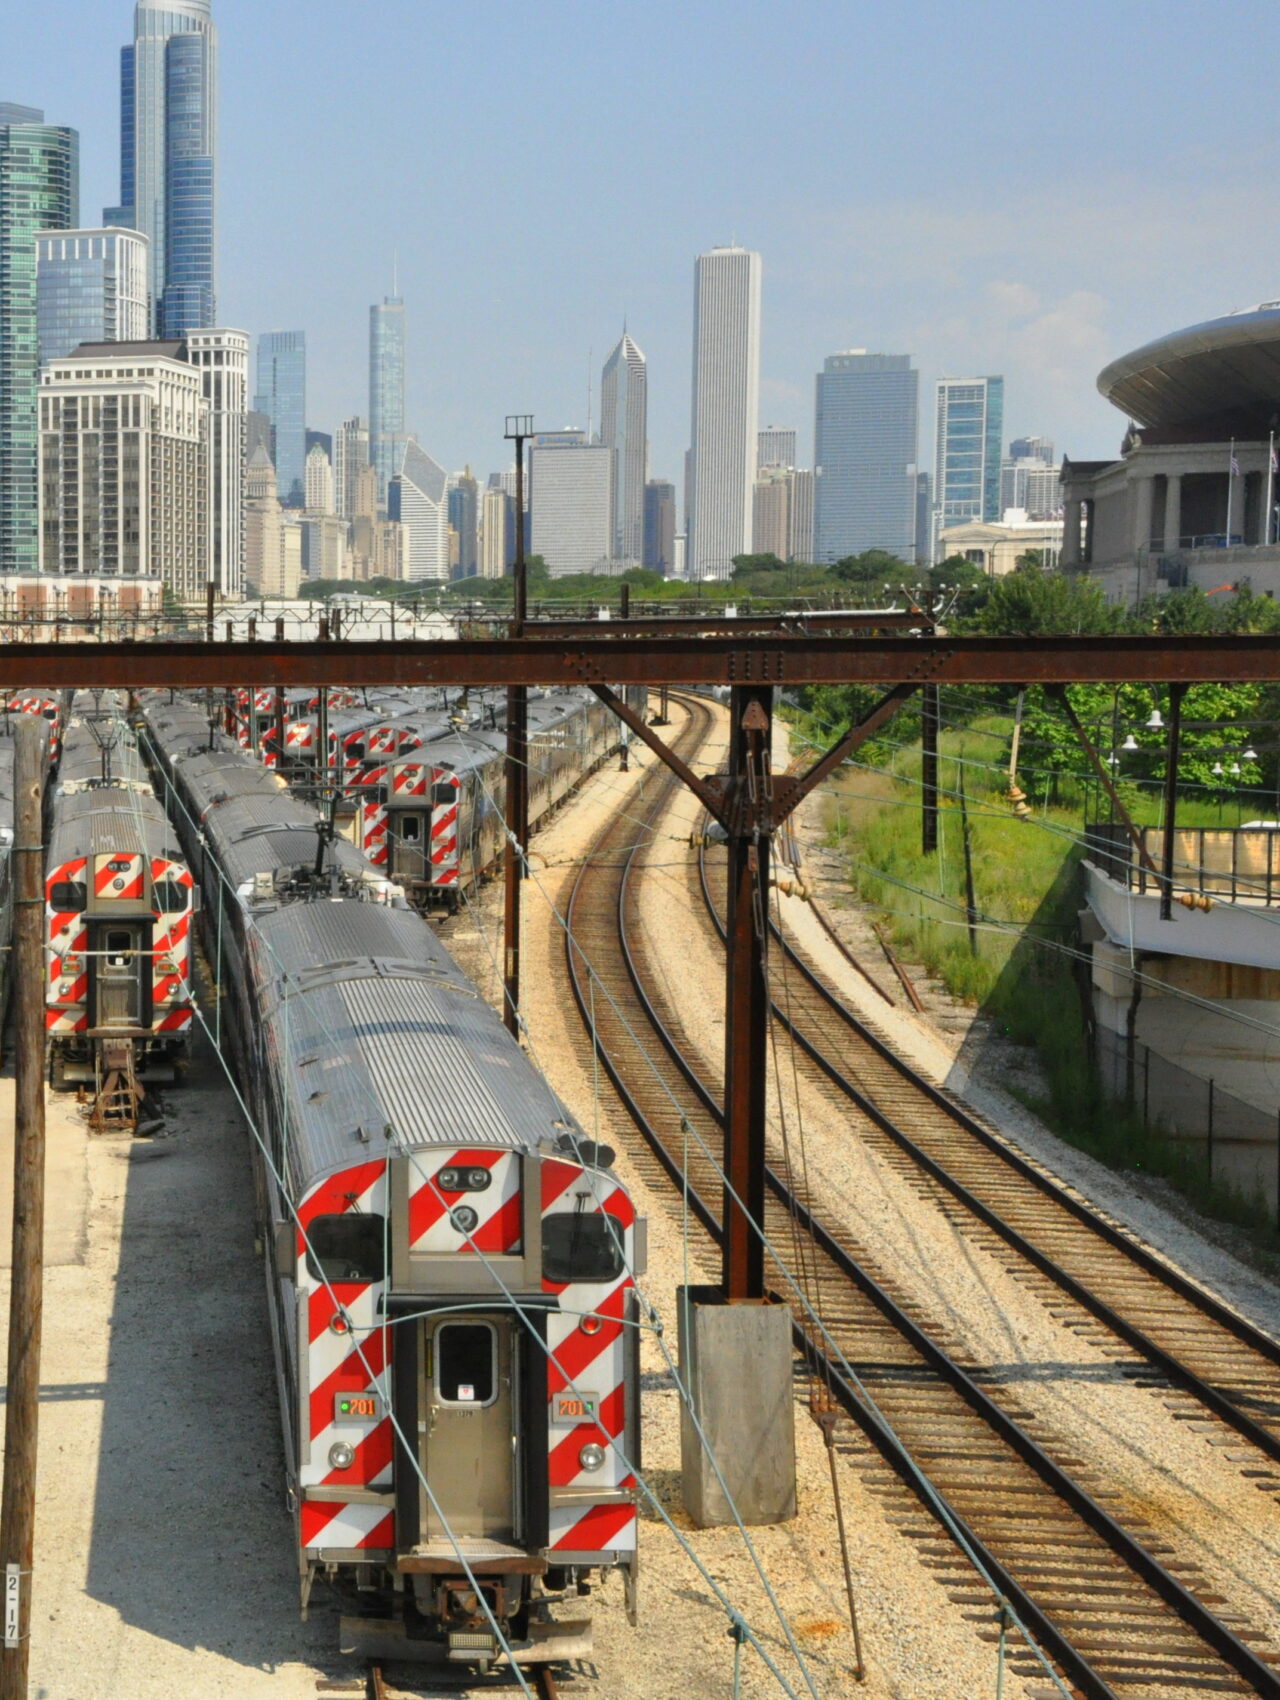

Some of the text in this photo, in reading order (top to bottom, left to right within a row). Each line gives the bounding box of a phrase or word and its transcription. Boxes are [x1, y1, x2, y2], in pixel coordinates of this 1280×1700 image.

[350, 1399, 373, 1415] 701
[559, 1400, 583, 1416] 701
[8, 1577, 17, 1638] 2-17
